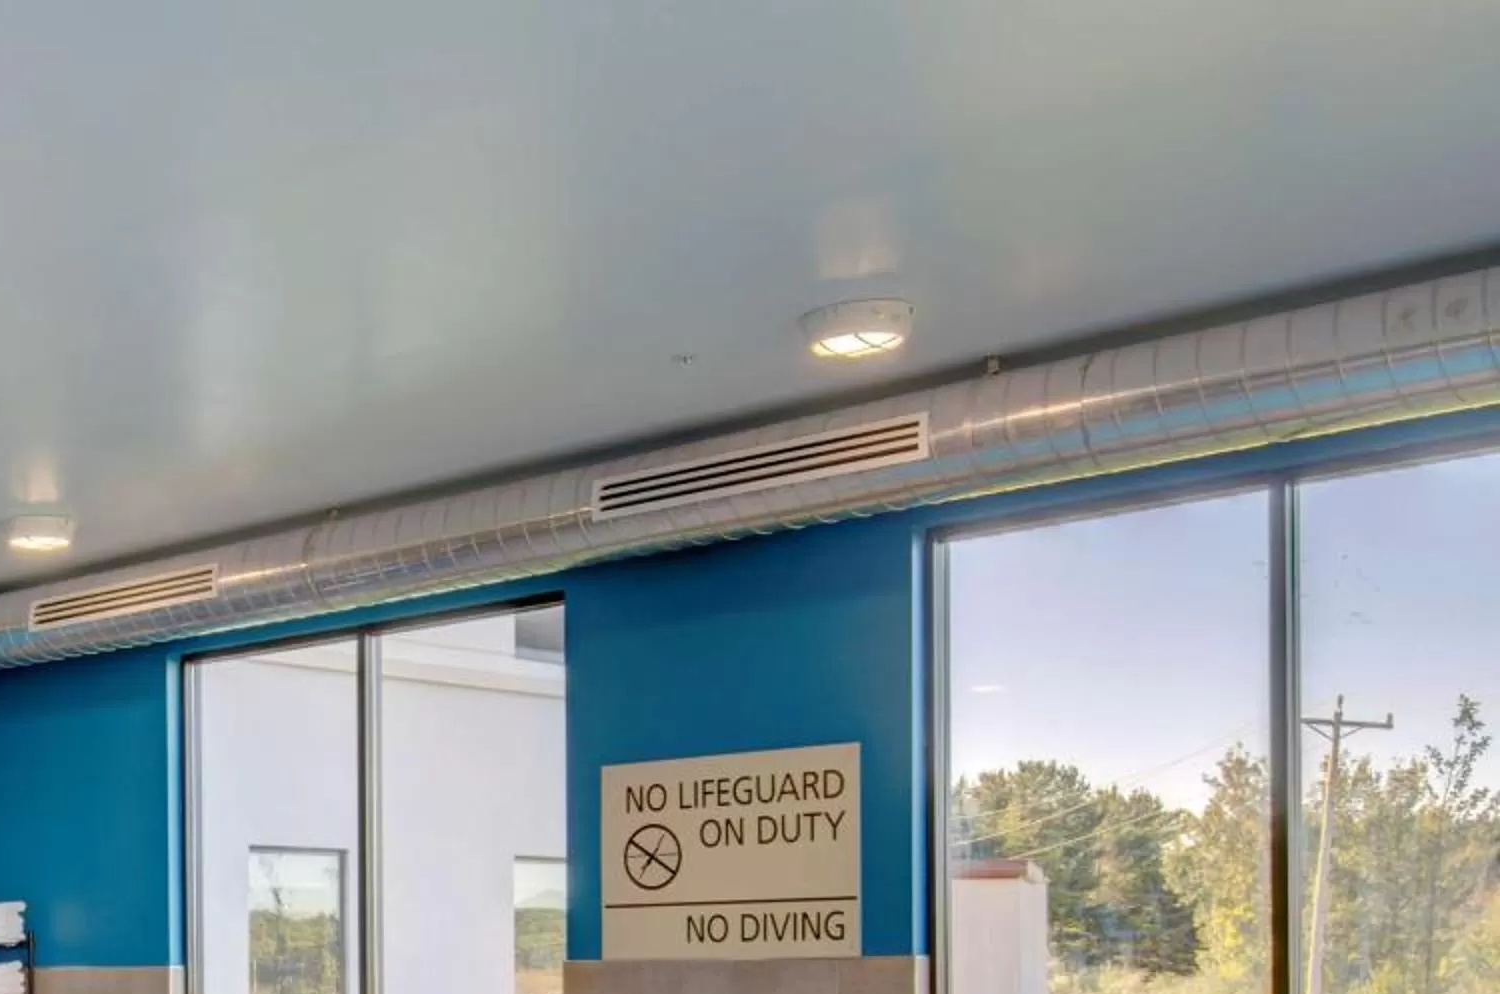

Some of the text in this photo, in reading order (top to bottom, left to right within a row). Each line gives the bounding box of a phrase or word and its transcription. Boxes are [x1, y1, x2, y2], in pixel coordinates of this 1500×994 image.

[626, 769, 845, 813] NO LIFEGUARD
[700, 810, 845, 848] ON DUTY
[687, 910, 845, 943] NO DIVING
